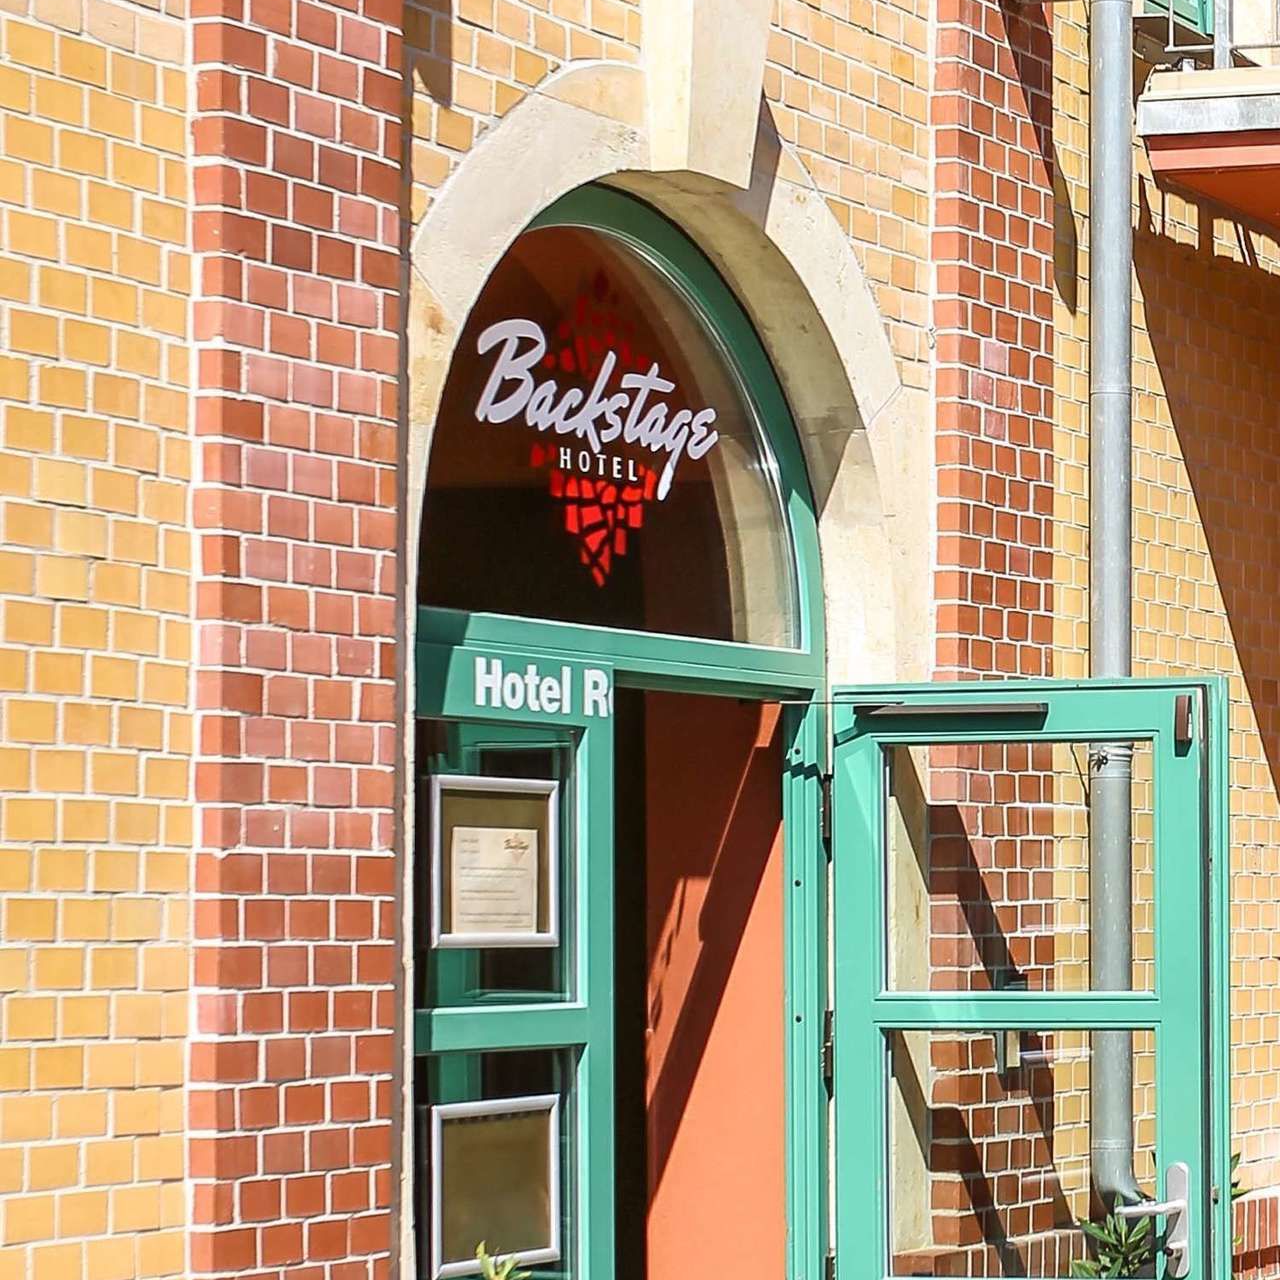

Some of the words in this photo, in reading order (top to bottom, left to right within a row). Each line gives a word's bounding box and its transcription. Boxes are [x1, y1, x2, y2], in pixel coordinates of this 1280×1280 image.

[476, 319, 720, 501] Backstage
[558, 446, 639, 482] HOTEL
[474, 655, 573, 715] Hotel
[583, 668, 614, 718] R
